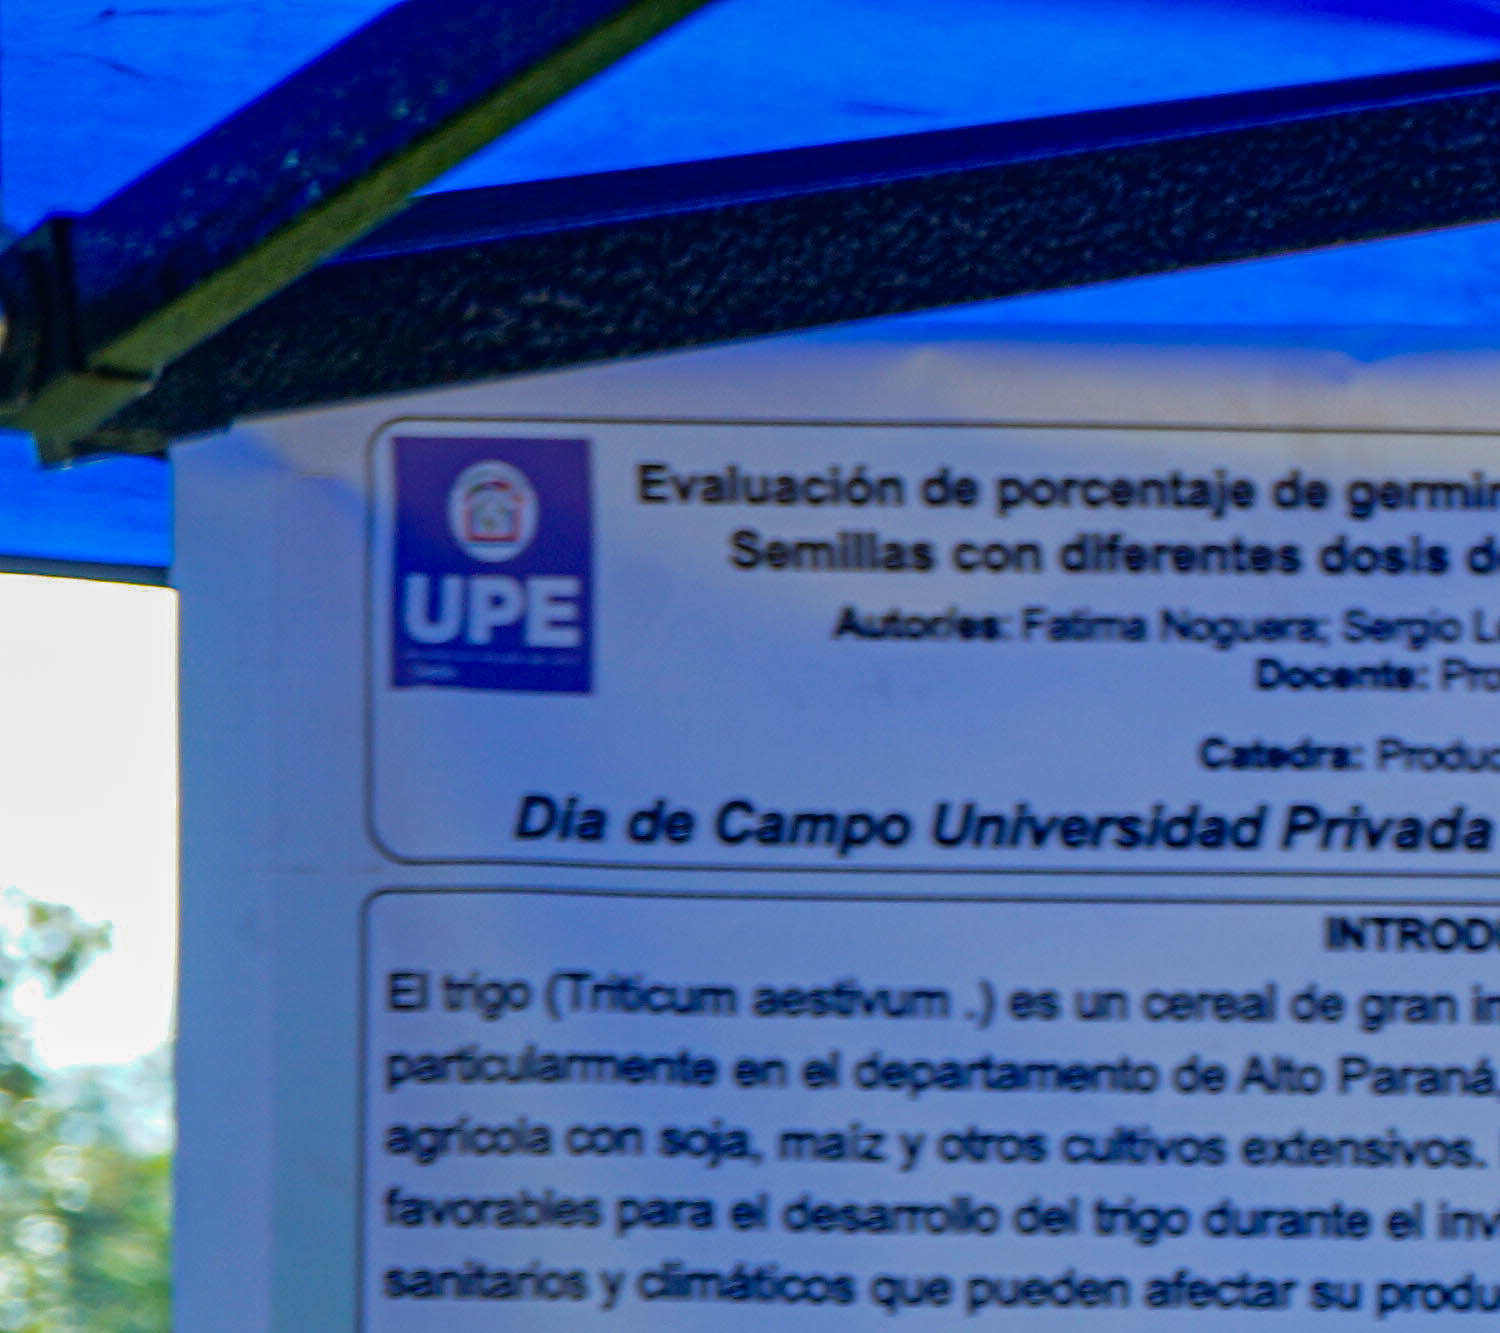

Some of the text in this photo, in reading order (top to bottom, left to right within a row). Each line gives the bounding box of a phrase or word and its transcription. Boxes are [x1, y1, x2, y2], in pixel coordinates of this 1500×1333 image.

[638, 463, 904, 507] Evaluación
[921, 467, 980, 508] de
[997, 469, 1257, 520] porcentaje
[1273, 470, 1331, 511] de
[731, 529, 937, 573] Semillas
[952, 541, 1043, 574] con
[1060, 533, 1304, 576] diferentes
[1319, 534, 1451, 576] dosis
[404, 571, 582, 646] UPE
[1161, 608, 1328, 651] Noguera;
[1343, 608, 1462, 652] Sergio
[1255, 657, 1428, 692] Docente:
[627, 798, 696, 845] de
[714, 798, 913, 858] Campo
[931, 801, 1269, 851] Universidad
[1281, 803, 1494, 853] Privada
[388, 970, 428, 1013] El
[443, 974, 532, 1021] trigo
[546, 970, 738, 1020] (Triticum
[752, 980, 950, 1019] aestivum
[1008, 989, 1061, 1021] es
[1076, 990, 1128, 1022] un
[1142, 983, 1276, 1023] cereal
[1291, 984, 1345, 1023] de
[1360, 992, 1457, 1034] gran
[384, 1186, 603, 1229] favorables
[617, 1197, 716, 1237] para
[729, 1193, 768, 1232] el
[783, 1195, 1001, 1236] desarrollo
[1013, 1197, 1079, 1236] del
[1093, 1198, 1191, 1247] trigo
[1203, 1199, 1372, 1241] durante
[1385, 1202, 1423, 1241] el
[384, 1262, 589, 1301] sanitarios
[601, 1271, 625, 1311] y
[637, 1261, 857, 1306] climáticos
[870, 1275, 953, 1314] que
[967, 1269, 1130, 1315] pueden
[1144, 1268, 1298, 1310] afectar
[1310, 1279, 1362, 1311] su
